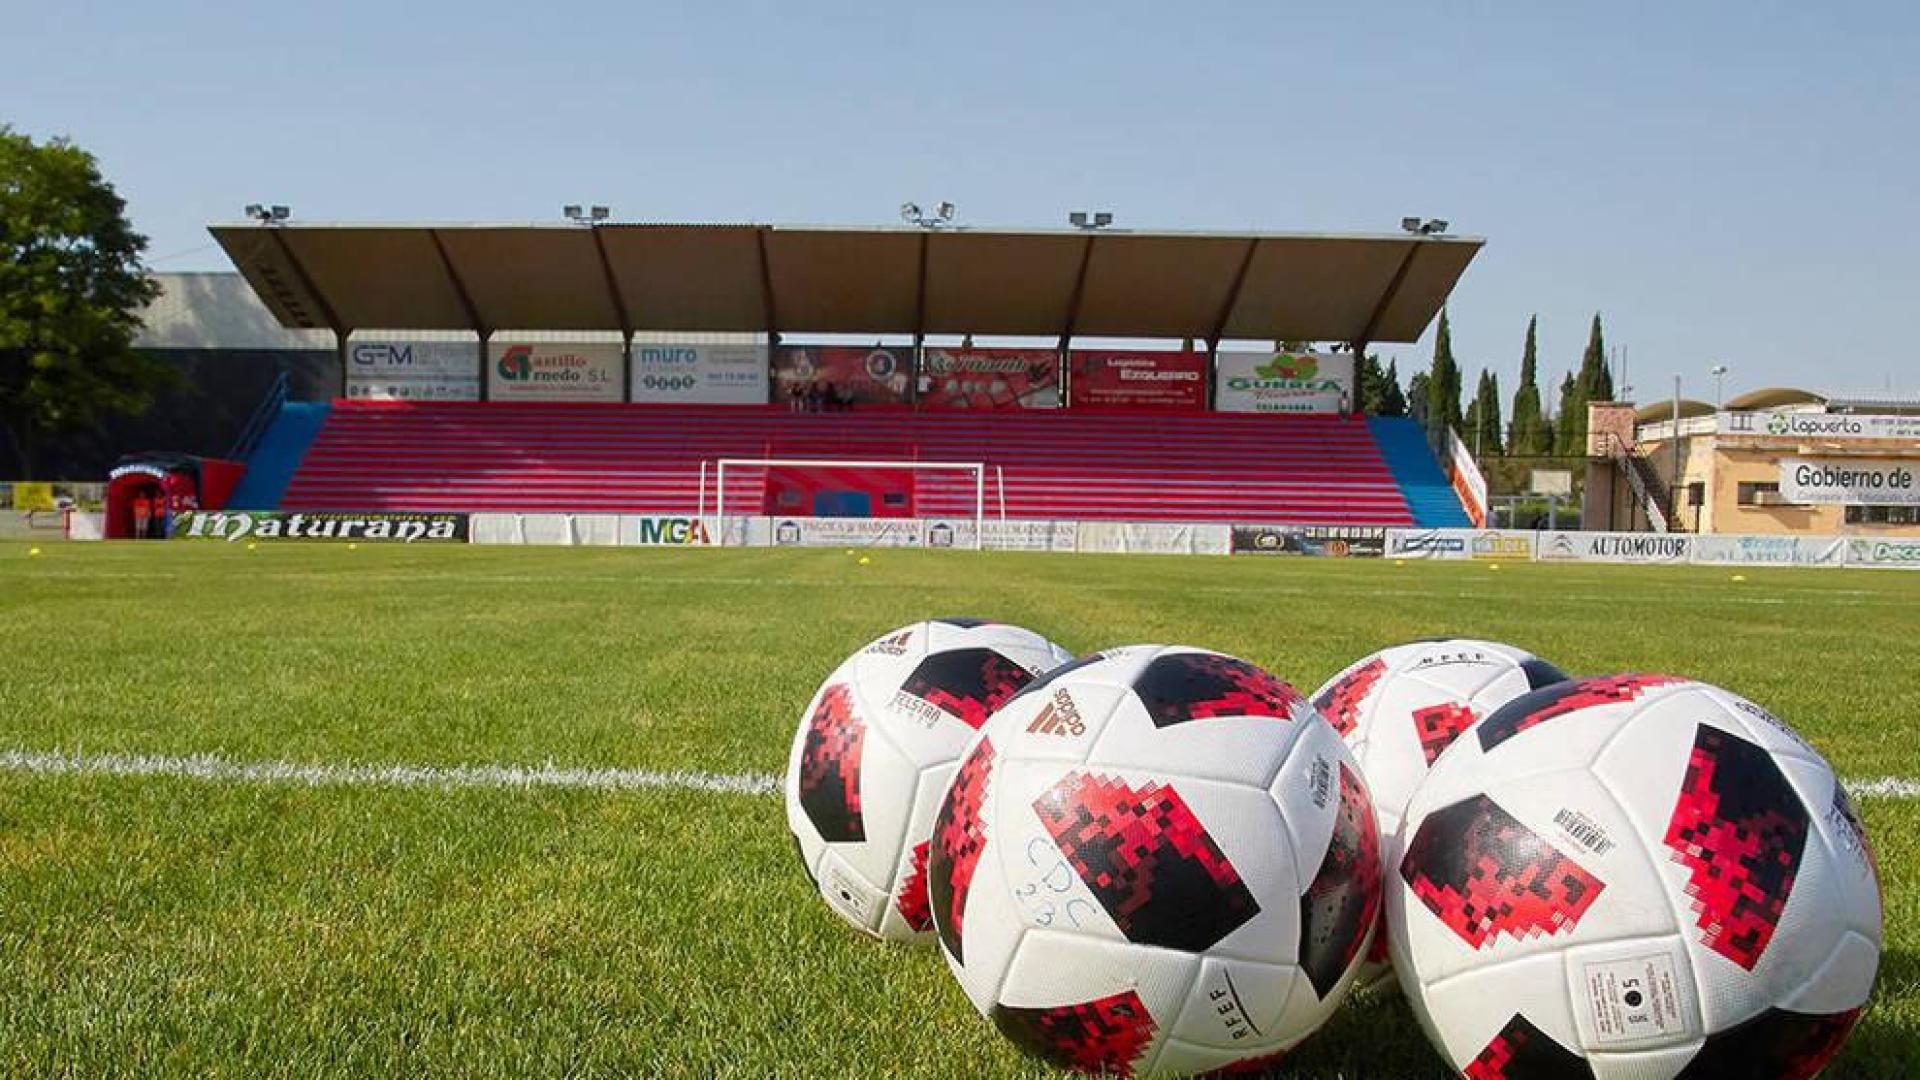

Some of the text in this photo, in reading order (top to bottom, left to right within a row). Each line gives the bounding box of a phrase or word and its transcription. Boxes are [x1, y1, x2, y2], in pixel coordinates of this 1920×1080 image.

[641, 348, 697, 363] muro
[1795, 464, 1912, 489] Gobierno de
[184, 513, 457, 542] Maturana
[639, 518, 711, 544] MGA
[1590, 536, 1686, 557] AUTOMOTOR
[1054, 687, 1087, 737] adidas
[1209, 988, 1250, 1041] RFEF
